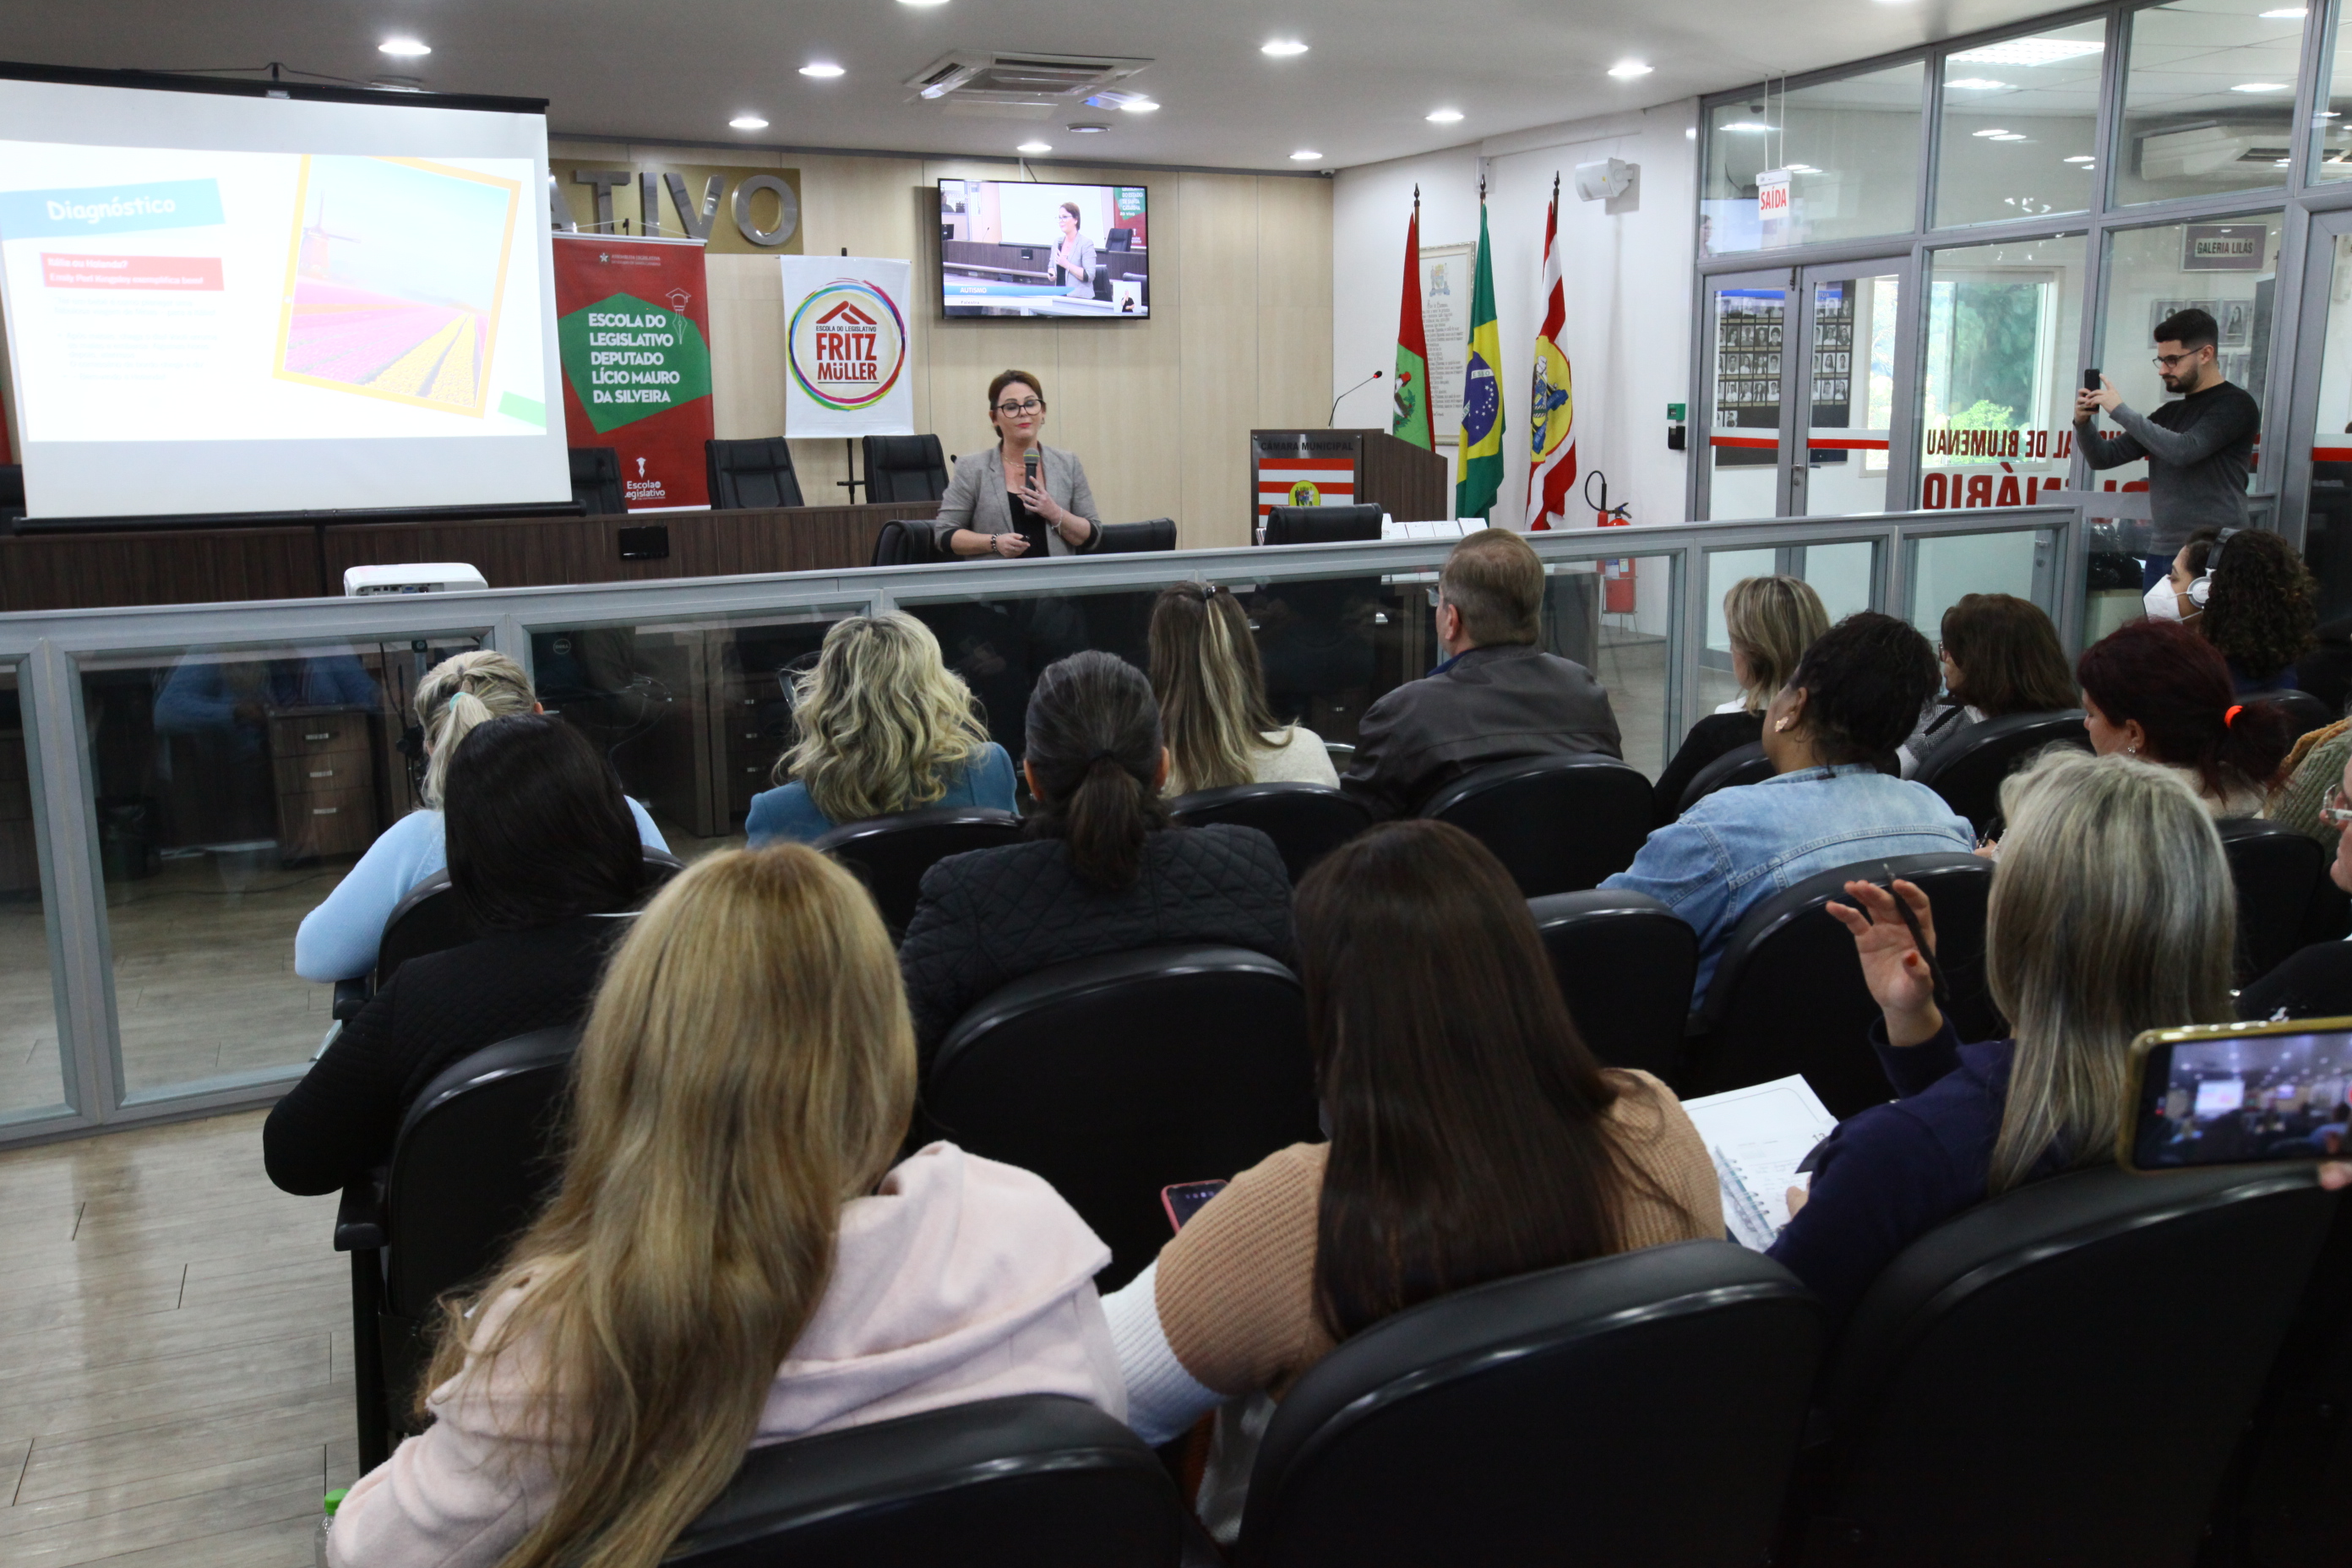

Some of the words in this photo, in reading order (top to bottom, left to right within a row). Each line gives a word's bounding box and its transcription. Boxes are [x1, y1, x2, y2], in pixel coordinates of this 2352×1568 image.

[1760, 186, 1787, 210] SAÍDA
[47, 196, 176, 225] Diagnóstico
[2197, 242, 2230, 254] GALERIA
[2231, 239, 2253, 254] LILÁS
[589, 313, 644, 328] ESCOLA
[645, 314, 667, 328] DO
[590, 332, 674, 347] LEGISLATIVO
[816, 333, 877, 361] FRITZ
[591, 351, 664, 365] DEPUTADO
[592, 367, 630, 384] LÍCIO
[632, 370, 680, 384] MAURO
[593, 389, 613, 403] DA
[615, 389, 671, 403] SILVEIRA
[1260, 440, 1299, 451] CÂMARA
[1302, 442, 1353, 451] MUNICIPAL
[627, 480, 655, 489] Escola
[625, 488, 666, 500] egislativo
